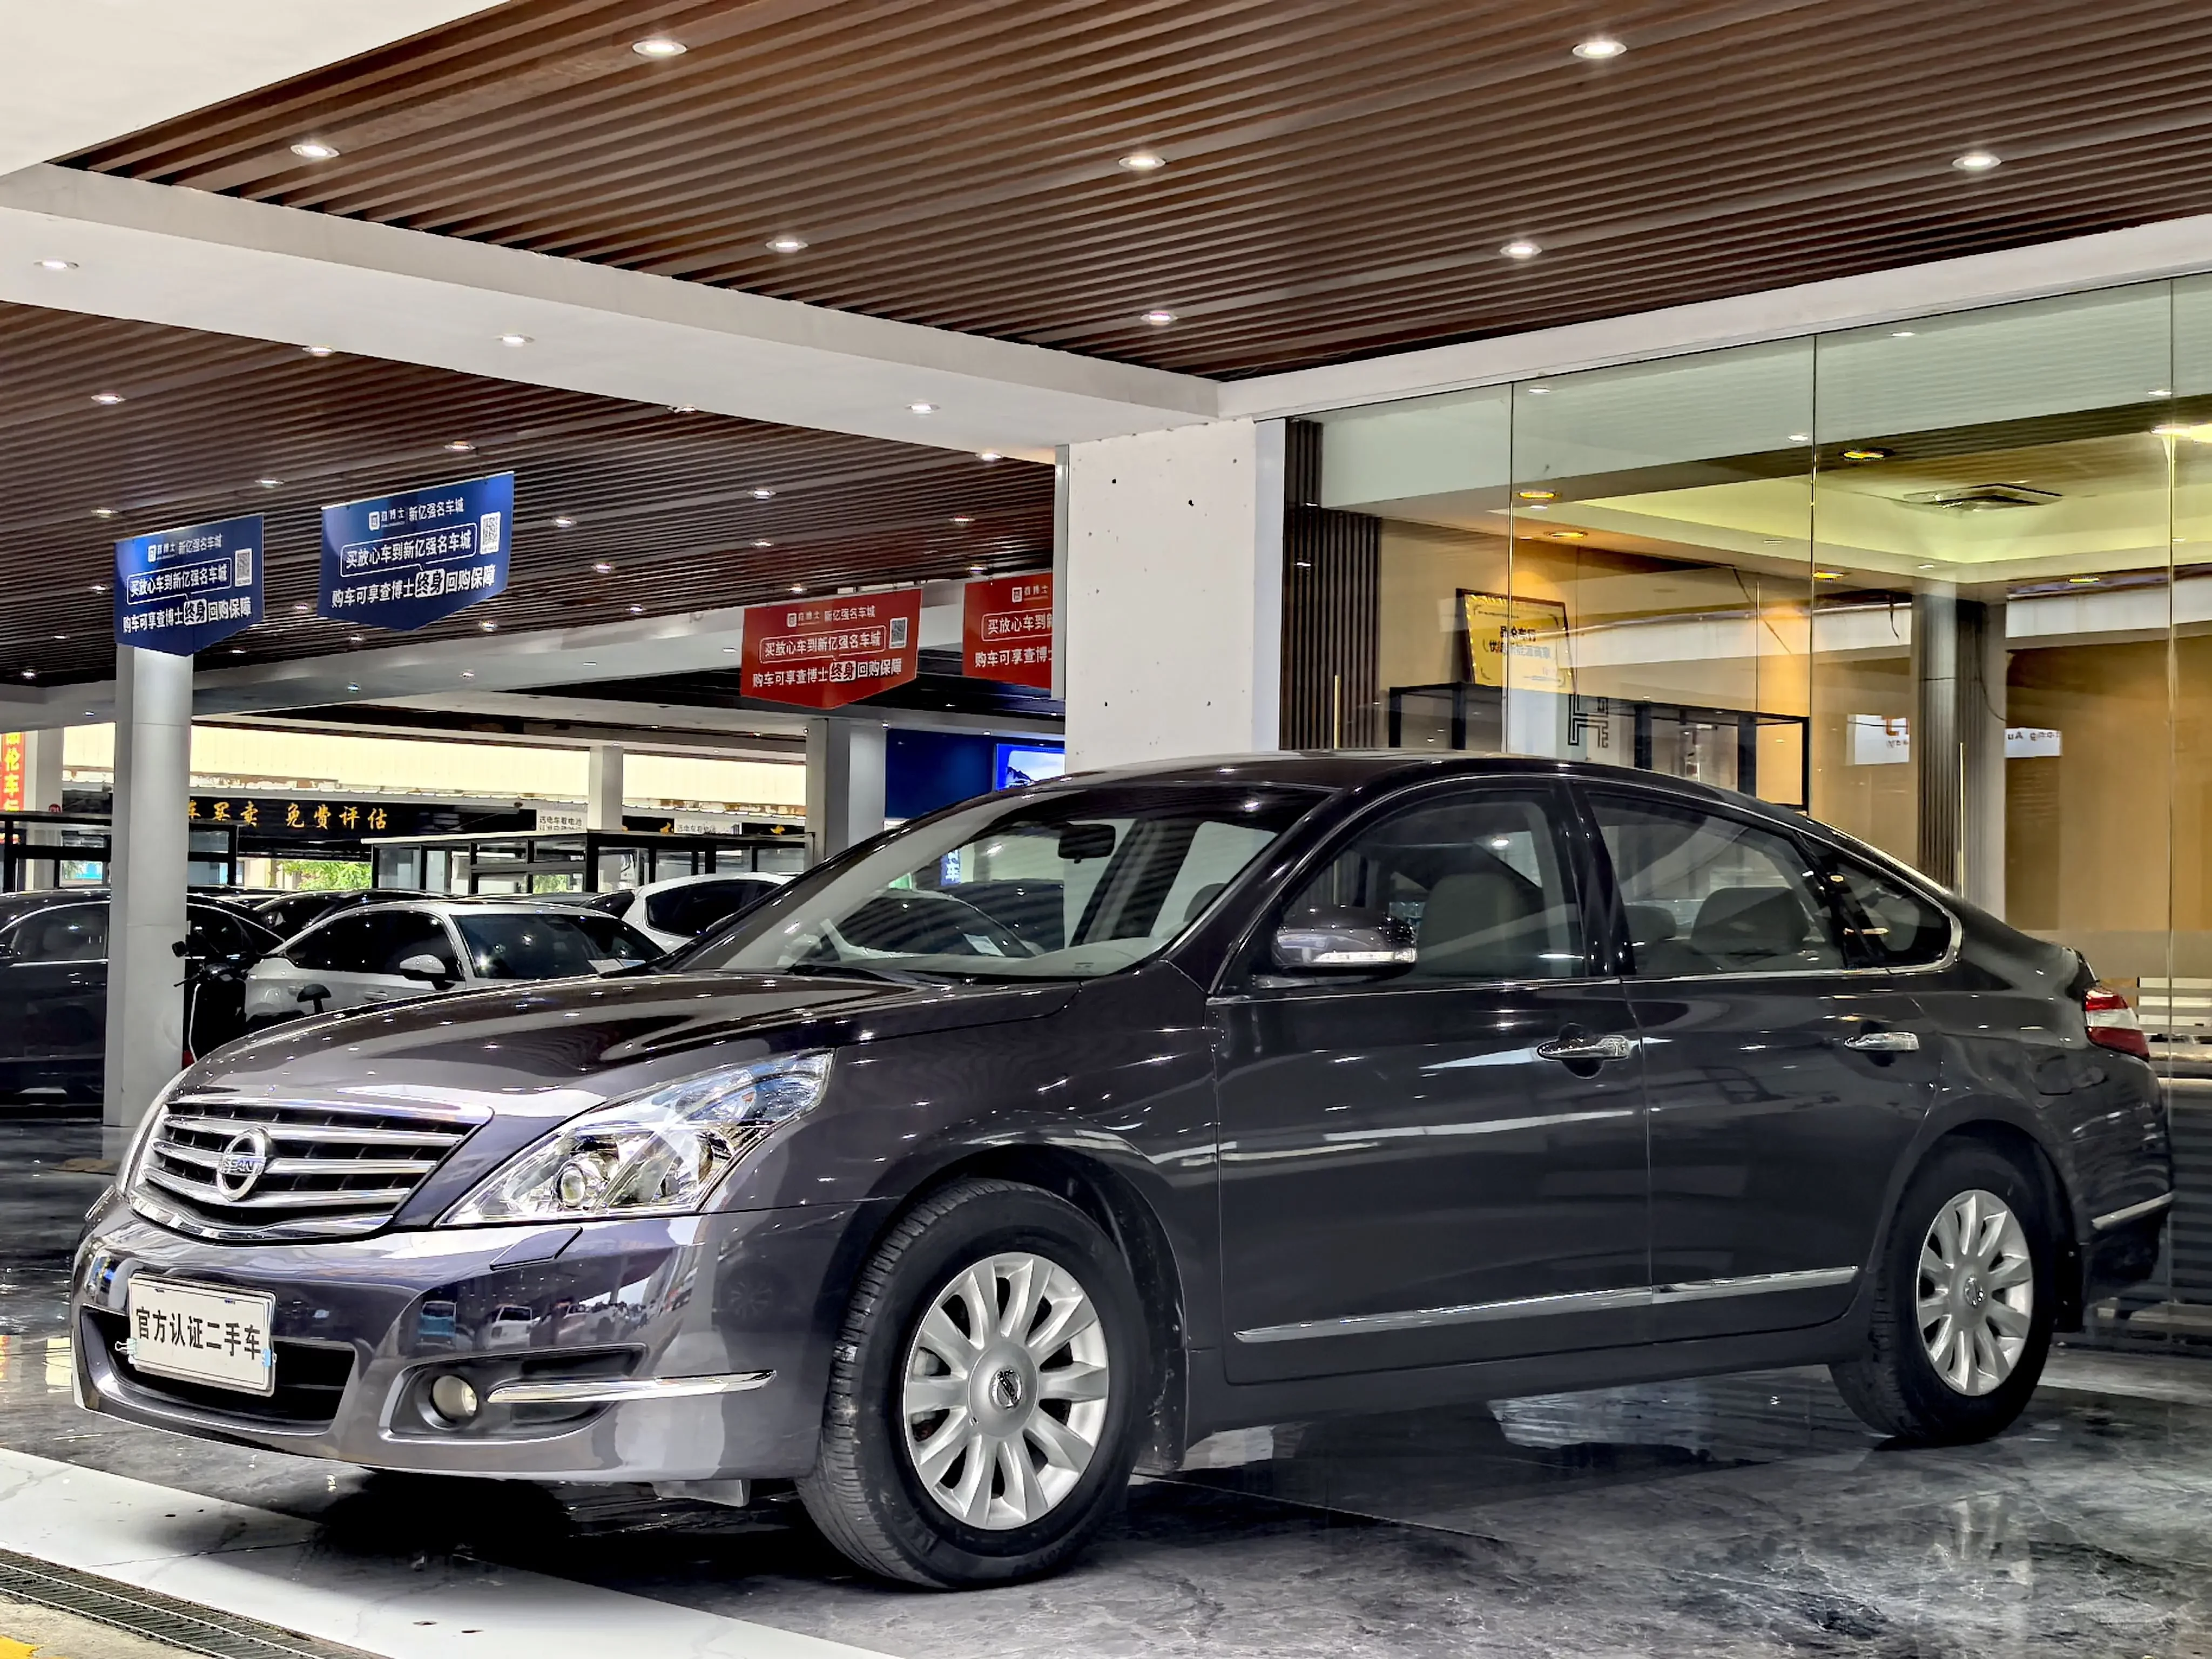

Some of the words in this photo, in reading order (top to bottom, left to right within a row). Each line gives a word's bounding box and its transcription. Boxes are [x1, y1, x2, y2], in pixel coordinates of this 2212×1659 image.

[346, 530, 472, 569] 买放心车到新亿强名车城
[129, 563, 227, 597] 买放心车到新亿强名车城
[331, 563, 496, 609] 购车可享查博士终身回购保障
[765, 630, 881, 657] 买放心车到新亿强名车城
[285, 802, 388, 830] 免费评估
[136, 1306, 261, 1360] 官方认证二手车
